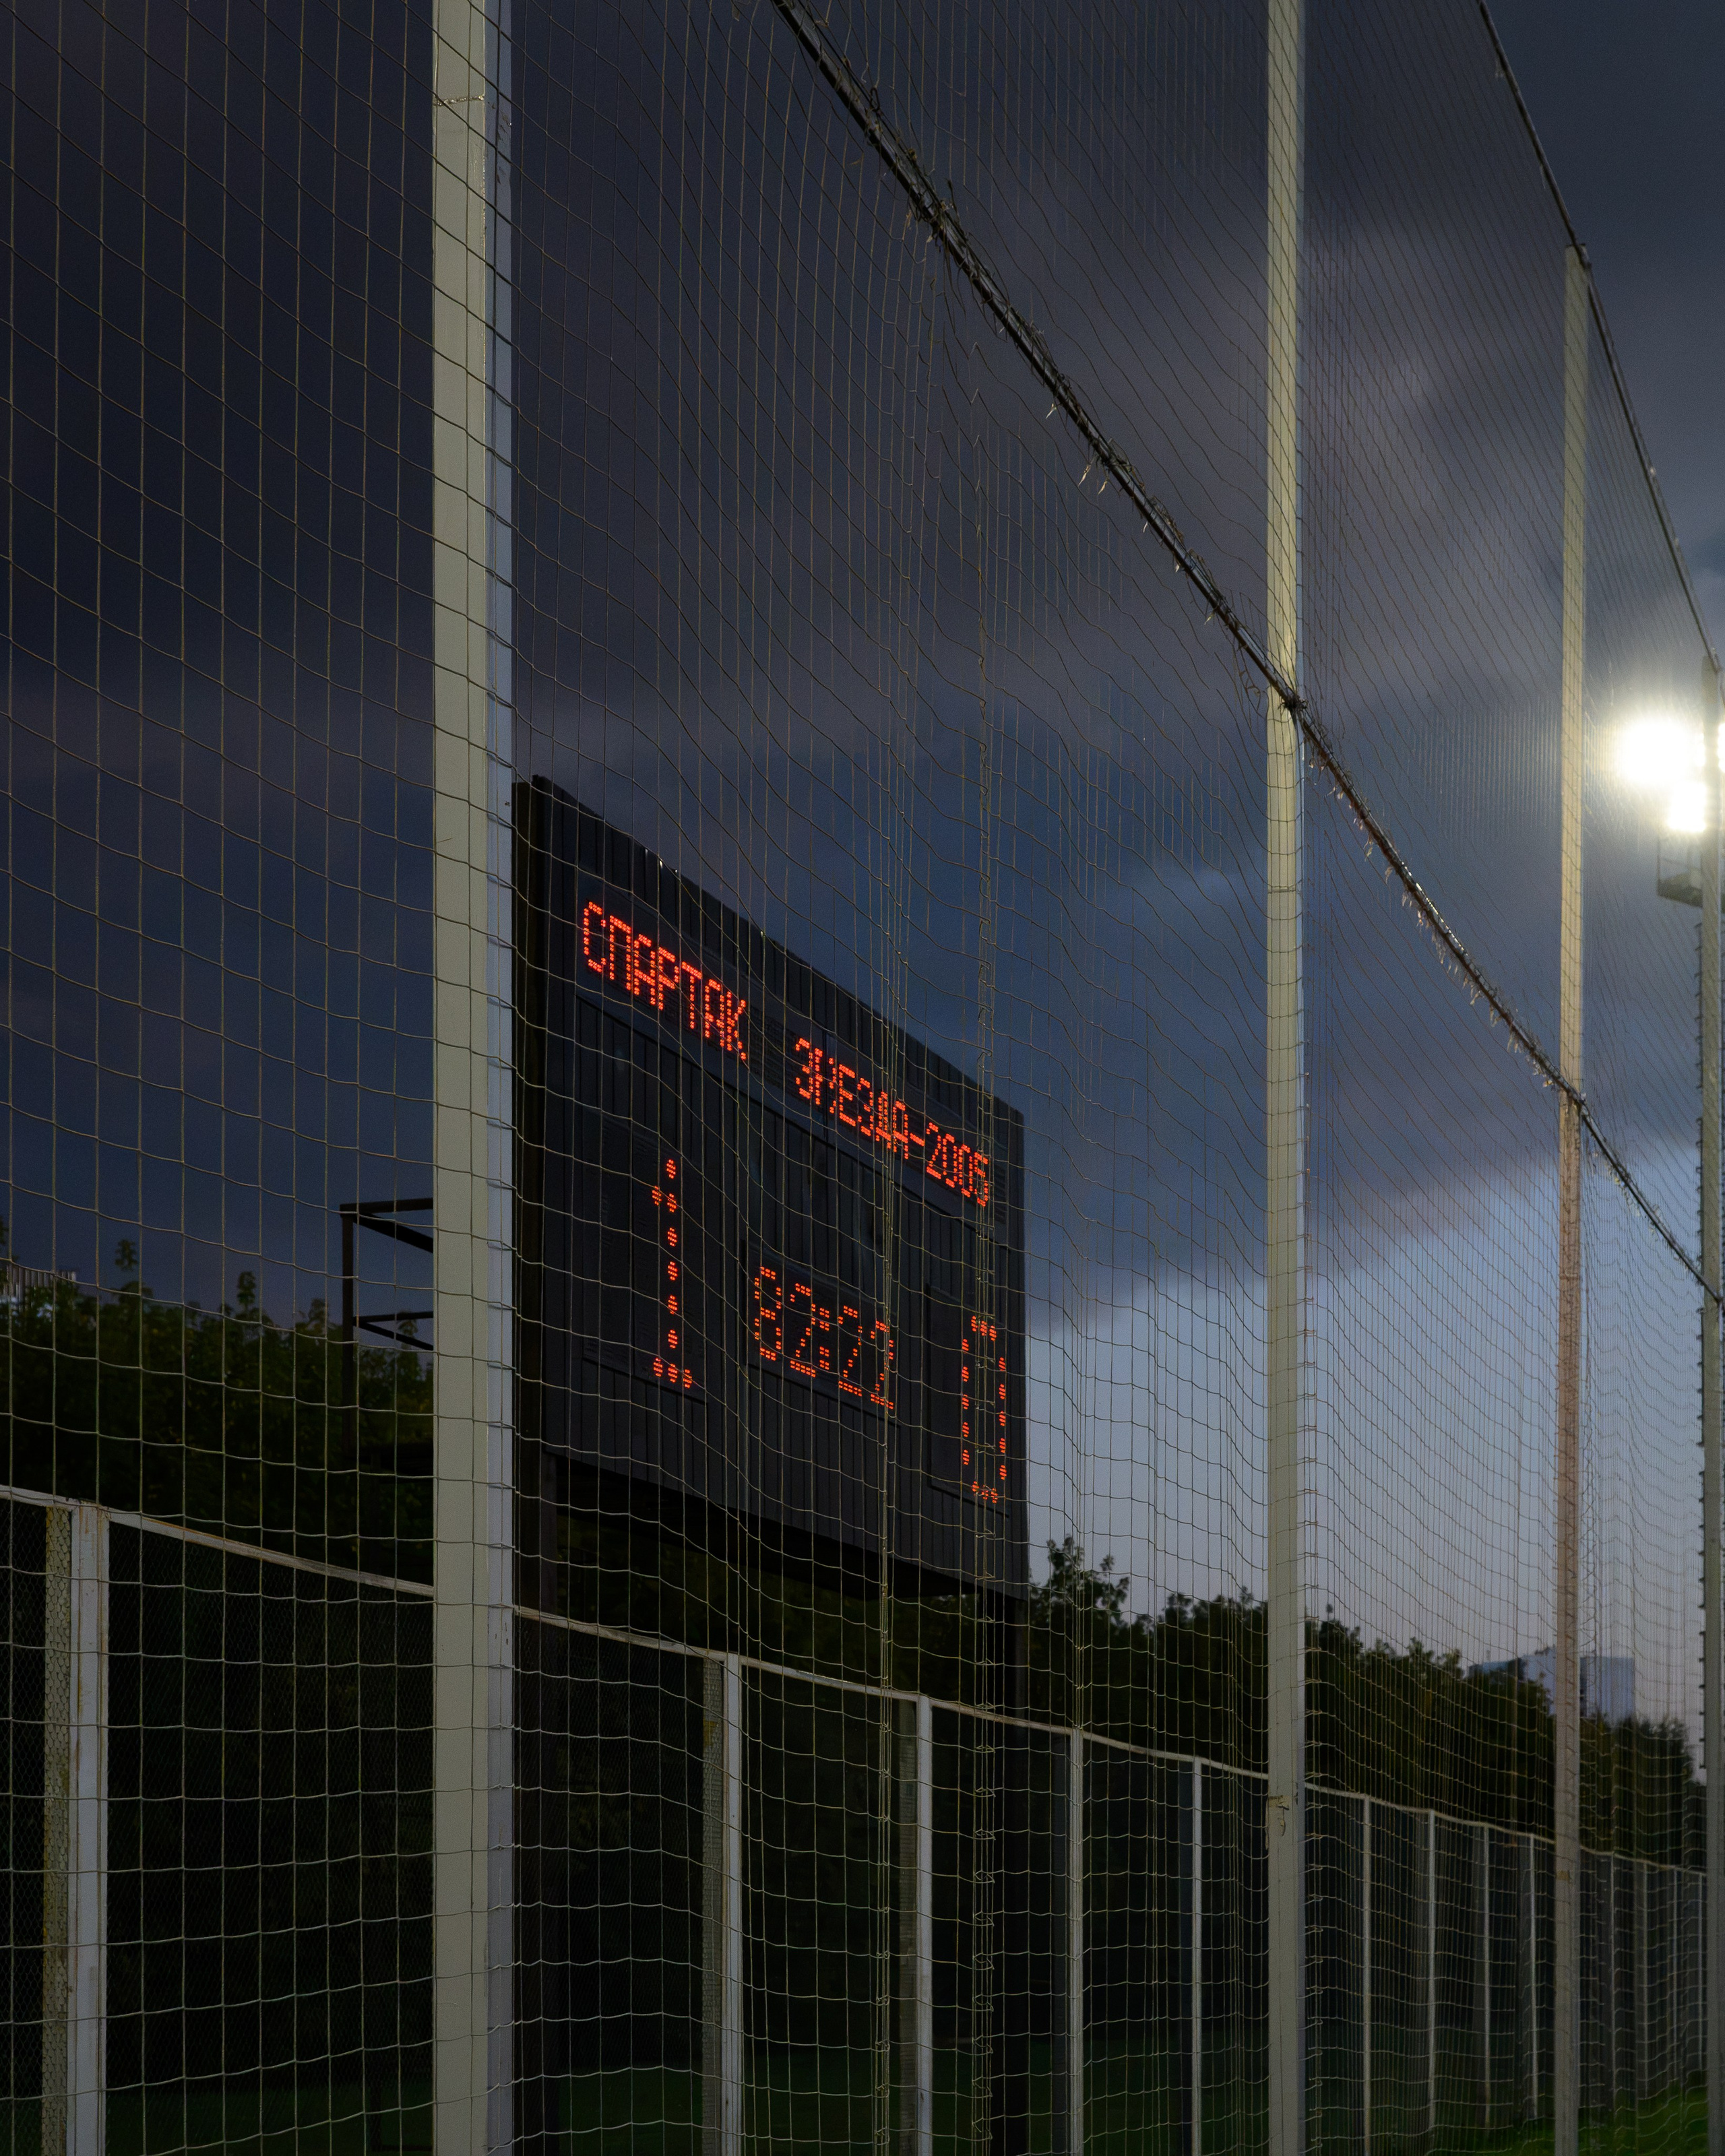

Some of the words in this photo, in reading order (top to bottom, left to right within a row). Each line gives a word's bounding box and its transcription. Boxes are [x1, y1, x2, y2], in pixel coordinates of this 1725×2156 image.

[582, 901, 747, 1060] СПАРТАК
[651, 1158, 693, 1389] 1
[753, 1265, 895, 1410] 82:22
[961, 1314, 1007, 1504] 0
